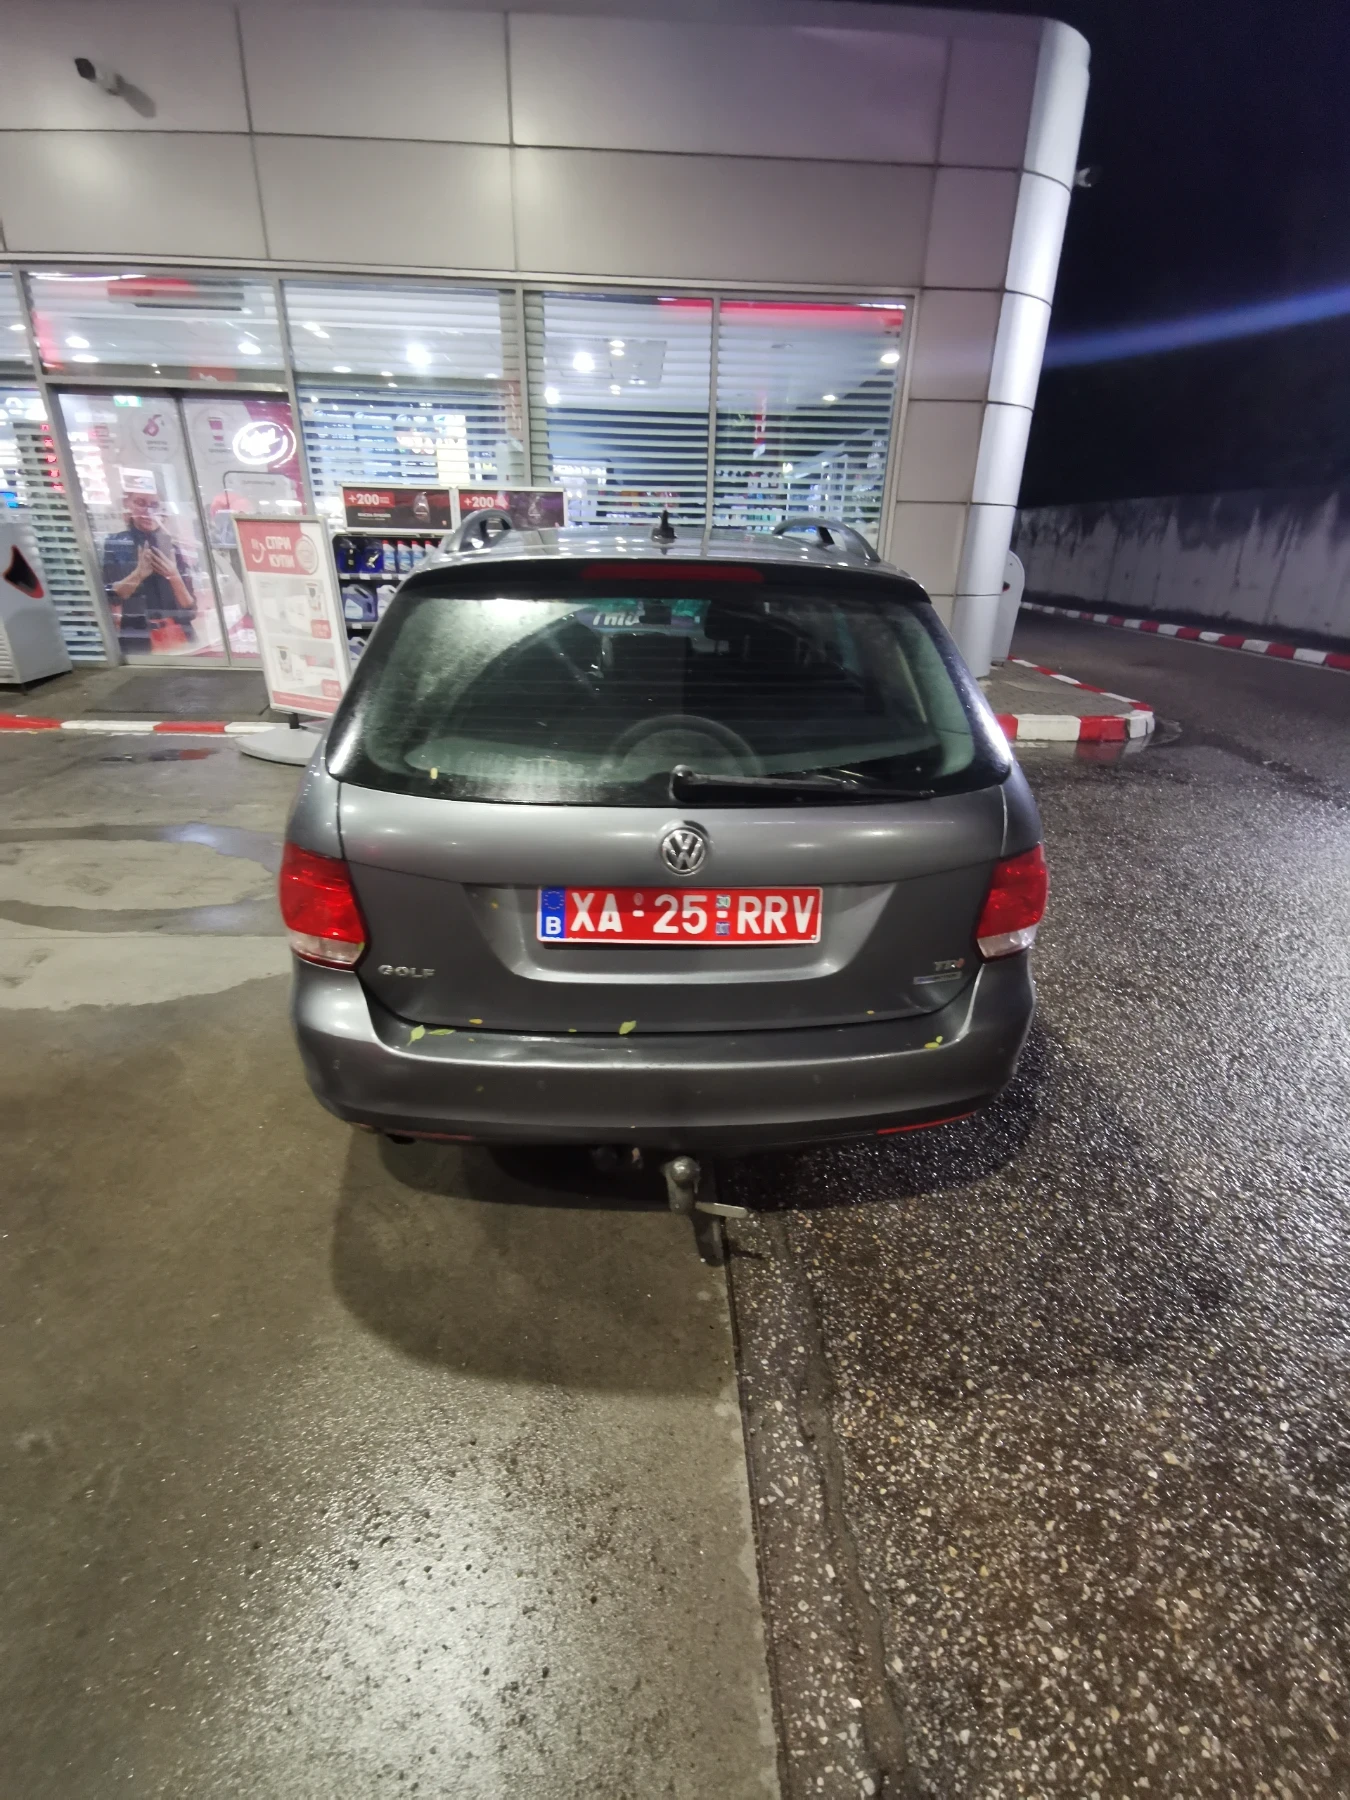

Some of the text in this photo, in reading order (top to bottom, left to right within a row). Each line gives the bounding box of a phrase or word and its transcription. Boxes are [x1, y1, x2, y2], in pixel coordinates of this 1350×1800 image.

[348, 493, 380, 506] +200
[463, 496, 495, 508] +200
[545, 916, 562, 936] B
[378, 964, 436, 979] GOLF
